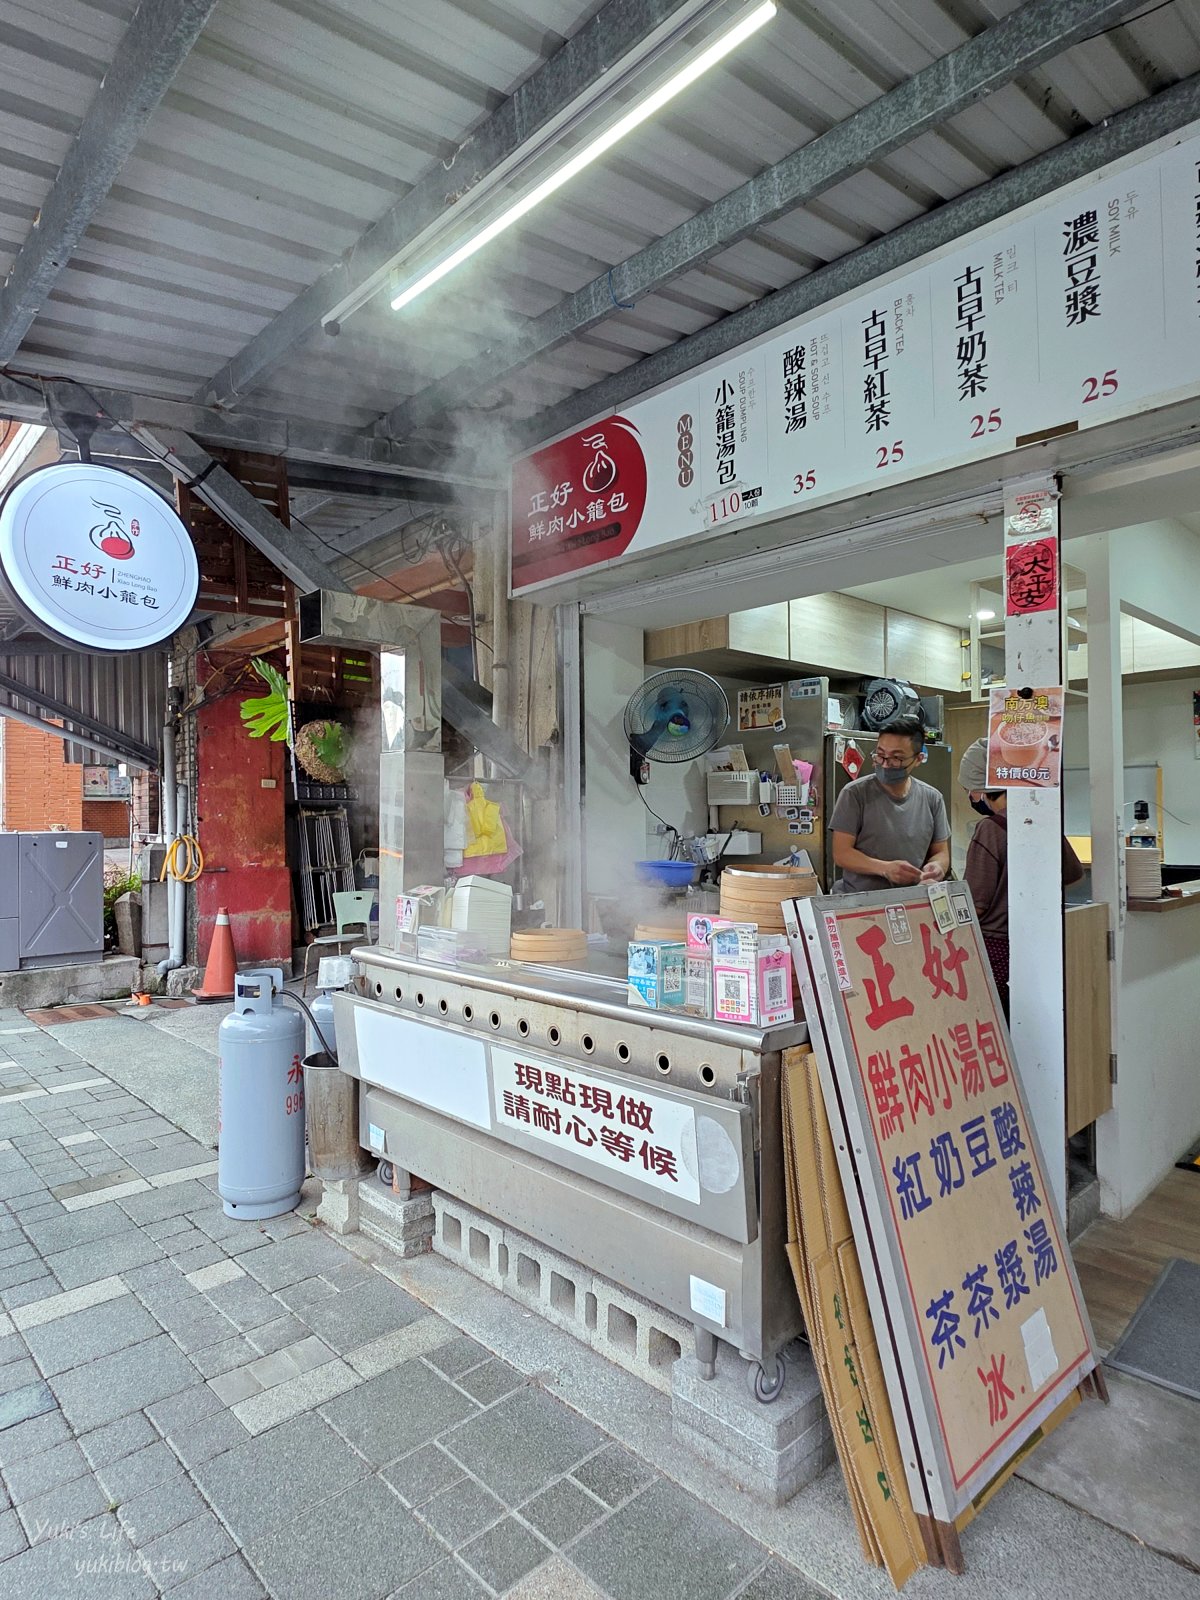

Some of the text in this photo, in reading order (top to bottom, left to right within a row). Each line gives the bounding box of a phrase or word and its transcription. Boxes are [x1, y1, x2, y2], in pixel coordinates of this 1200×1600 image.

[1107, 198, 1121, 257] SOY MILK
[993, 251, 1005, 305] MILK TEA
[1063, 209, 1101, 328] 濃豆漿
[894, 298, 905, 356] BLACK TEA
[953, 266, 988, 402] 古早奶茶
[783, 345, 807, 434] 酸辣湯
[810, 338, 820, 421] HOT & SOUR SOUP
[861, 310, 891, 434] 古早紅茶
[1081, 369, 1119, 404] 25
[714, 379, 736, 485] 小籠湯包
[738, 371, 747, 443] SOUP DUMPLING
[970, 408, 1002, 438] 25
[678, 416, 693, 485] MENU
[875, 440, 904, 469] 25
[527, 481, 573, 518] 正好
[710, 492, 740, 522] 110
[793, 469, 816, 494] 35
[528, 492, 629, 543] 鮮肉小籠包
[51, 555, 107, 579] 正好
[51, 574, 160, 610] 鮮肉小籠包
[117, 570, 152, 583] ZHENGHAO
[131, 581, 146, 591] Long
[740, 688, 782, 703] 請依序排隊
[1005, 695, 1049, 711] 南方澳
[996, 767, 1050, 780] 特價60元
[856, 921, 970, 1031] 正好
[514, 1062, 654, 1134] 現點現做
[867, 1019, 1008, 1141] 鮮肉小湯包
[503, 1090, 678, 1182] 請耐心等候
[990, 1101, 1059, 1287] 酸辣湯
